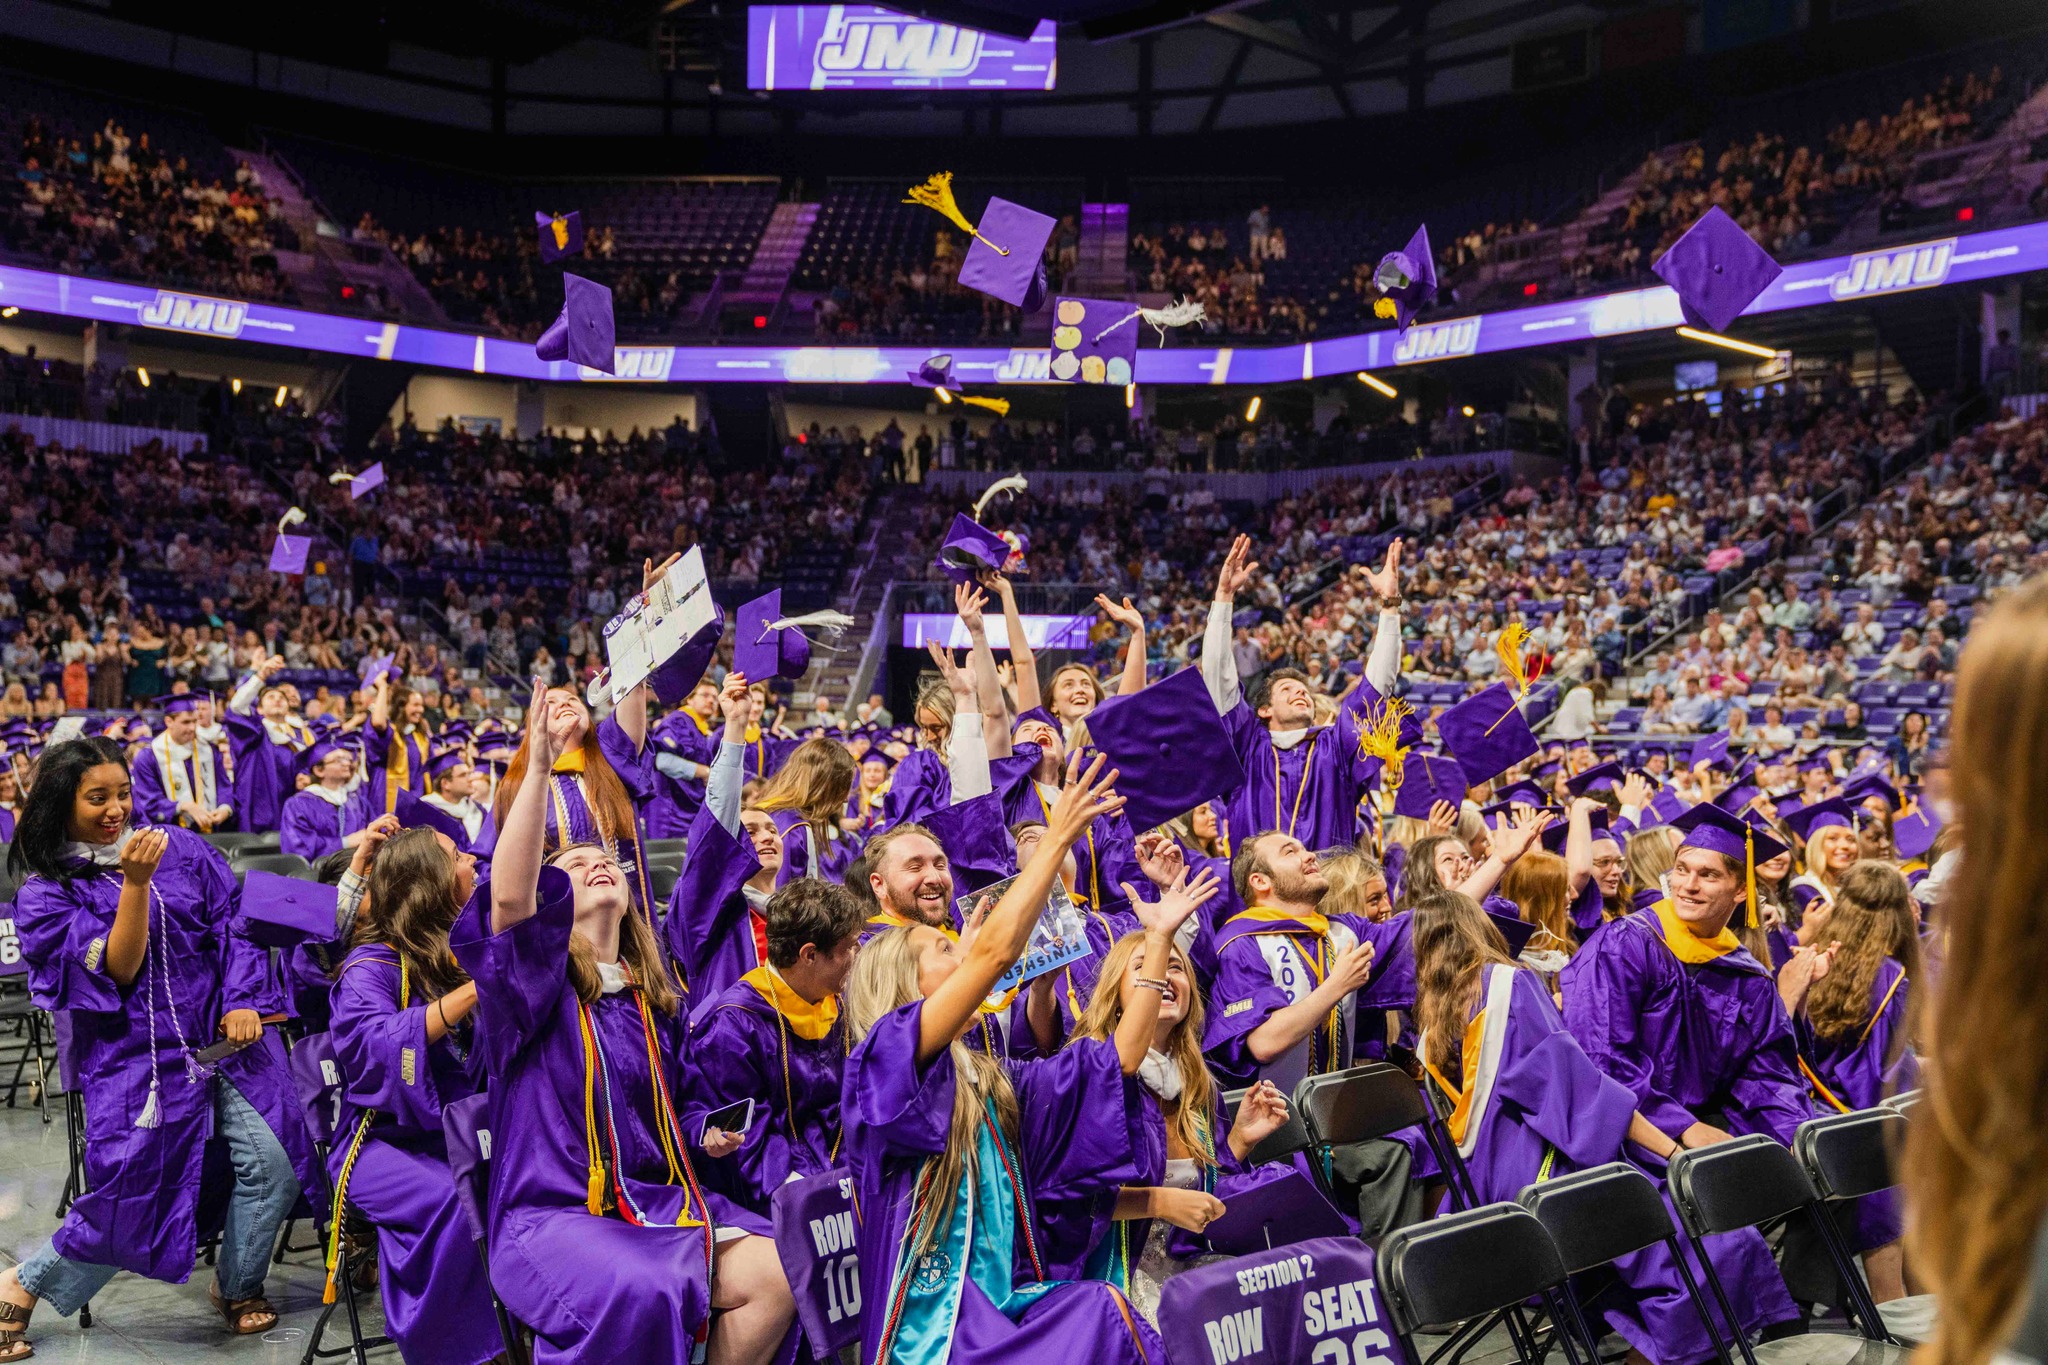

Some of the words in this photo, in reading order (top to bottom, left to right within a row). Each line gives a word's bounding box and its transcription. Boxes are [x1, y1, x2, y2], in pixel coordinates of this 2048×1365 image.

[819, 23, 979, 71] JMU
[1835, 244, 1952, 295] JMU
[142, 296, 243, 334] JMU
[1395, 322, 1475, 360] JMU
[582, 350, 668, 377] MU
[998, 353, 1051, 379] JM
[84, 937, 105, 971] JMU
[1003, 941, 1081, 981] FINISHED
[1224, 998, 1252, 1017] JMU
[823, 1253, 862, 1324] 10
[1236, 1261, 1303, 1296] SECTION
[1301, 1254, 1316, 1279] 2
[1303, 1278, 1379, 1337] SEAT
[1204, 1306, 1263, 1365] ROW
